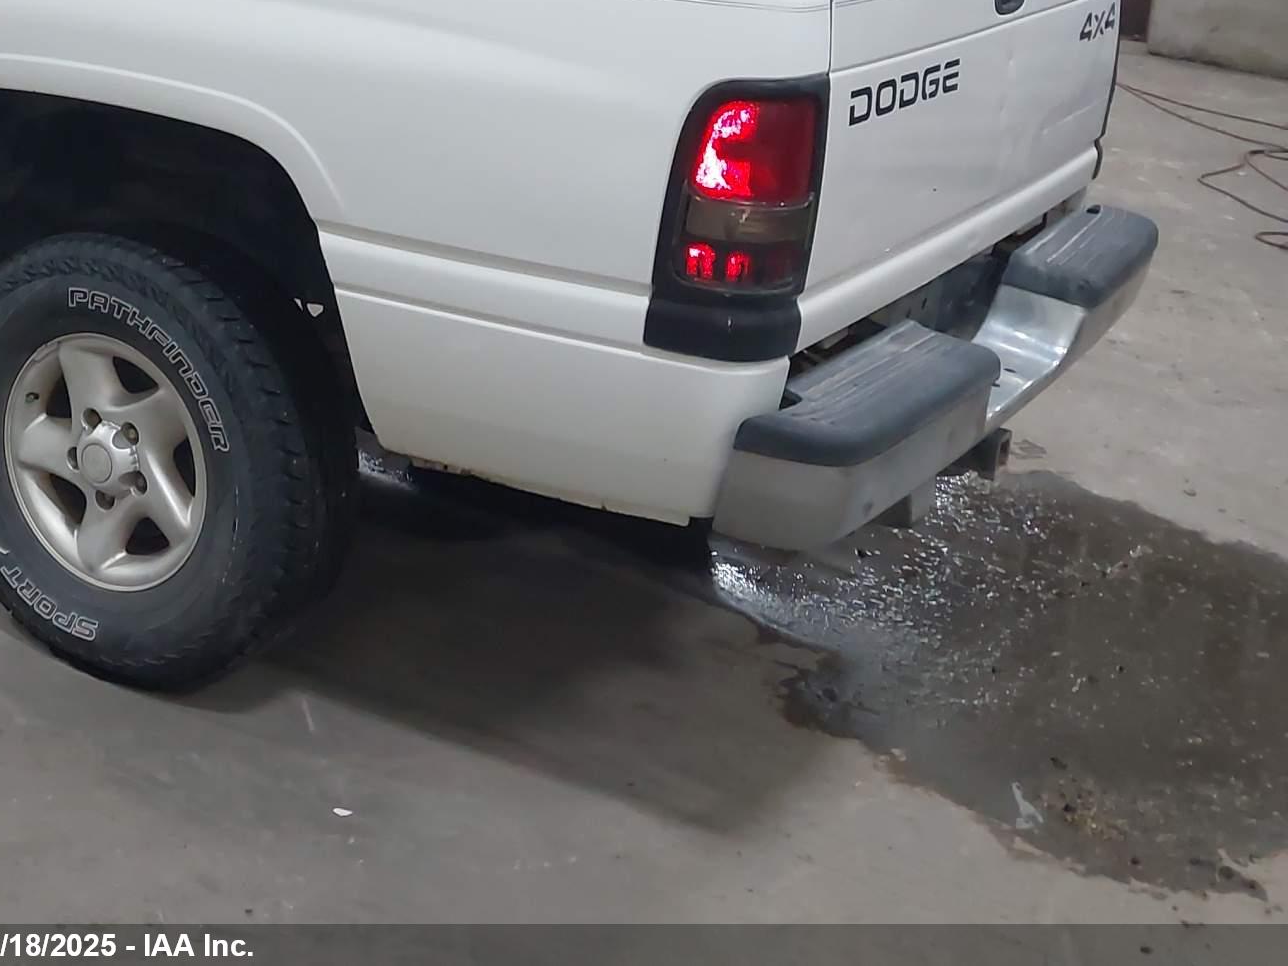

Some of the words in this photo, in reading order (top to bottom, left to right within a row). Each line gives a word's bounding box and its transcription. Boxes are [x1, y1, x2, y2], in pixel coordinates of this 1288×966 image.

[848, 57, 961, 127] DODGE
[68, 286, 230, 453] PATHFINDER
[0, 565, 99, 642] SPORT
